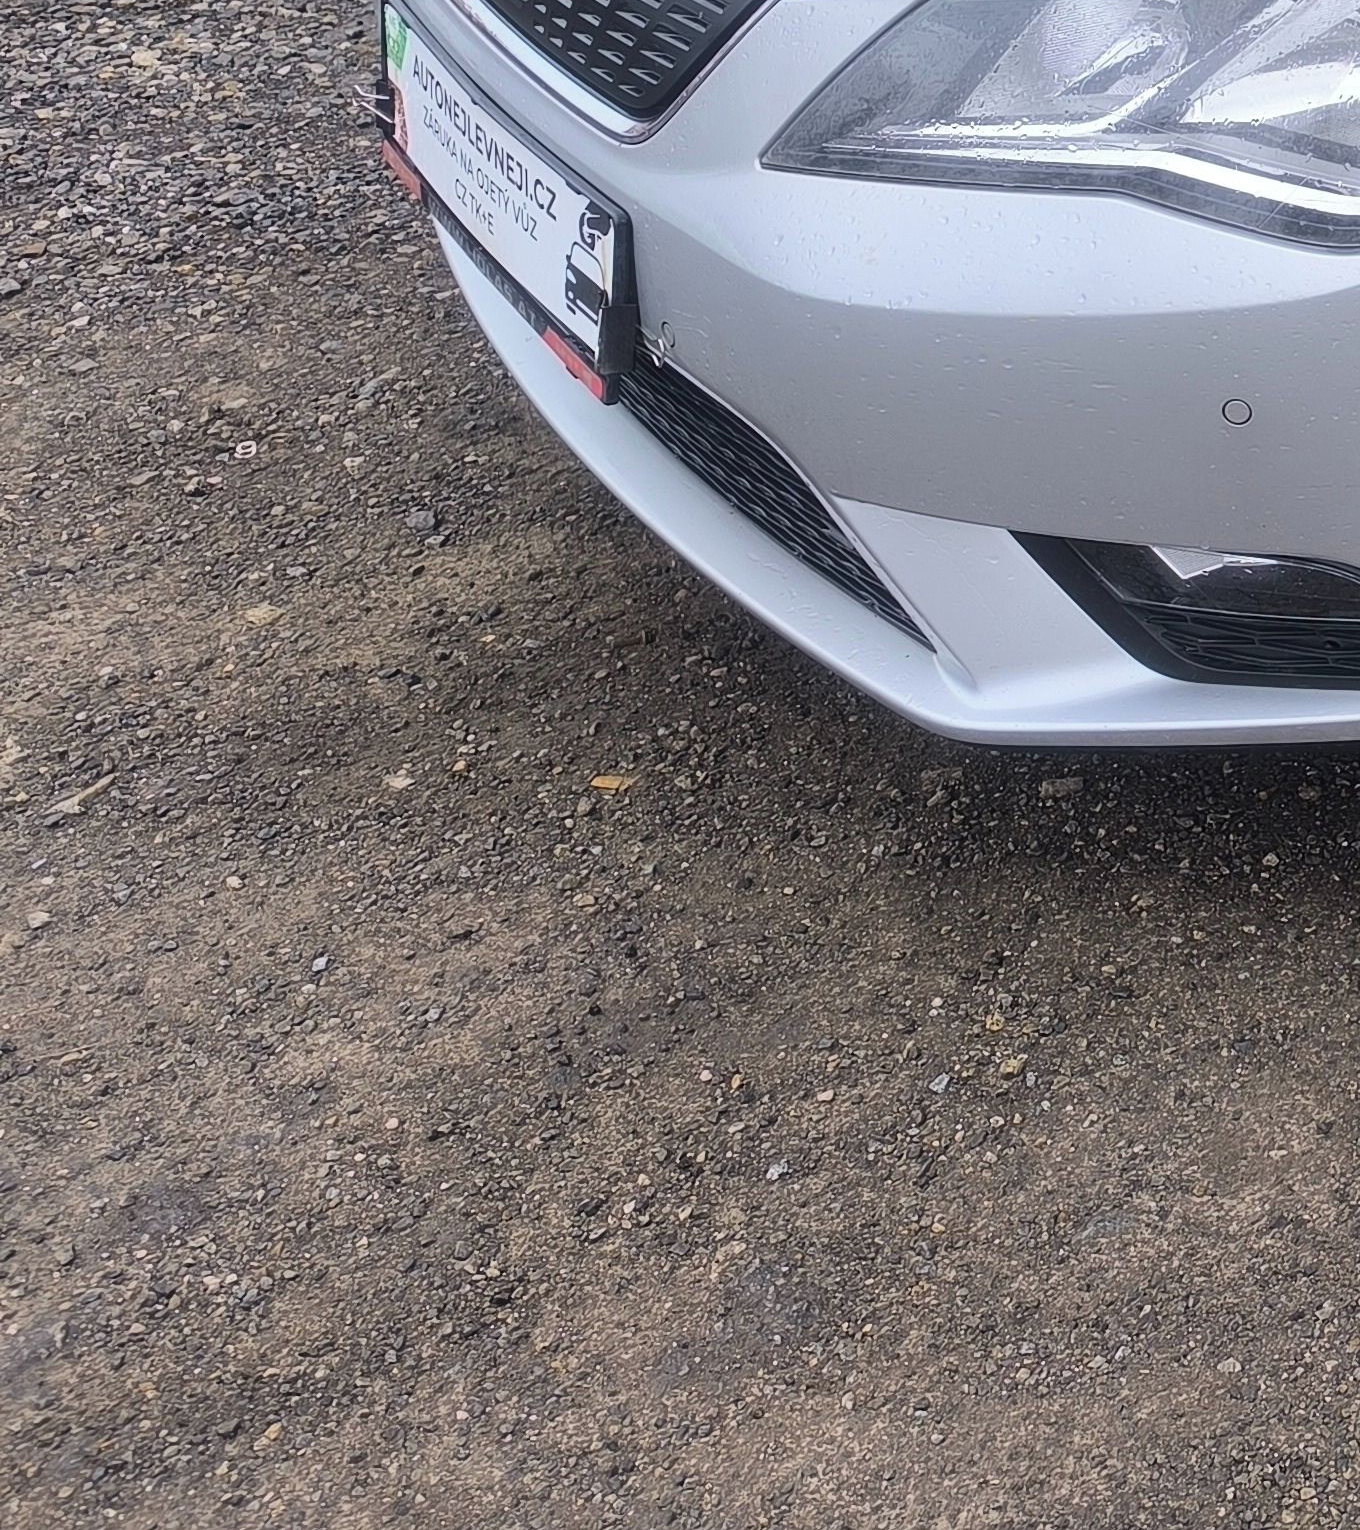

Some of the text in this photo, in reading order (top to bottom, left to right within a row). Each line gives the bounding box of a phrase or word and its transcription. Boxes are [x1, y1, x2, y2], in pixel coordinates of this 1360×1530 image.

[412, 54, 558, 223] AUTONEJLEVNEJI.CZ
[422, 104, 539, 242] ZÁRUKA NA OJETÝ VŮZ
[454, 178, 495, 237] CZ TK+E
